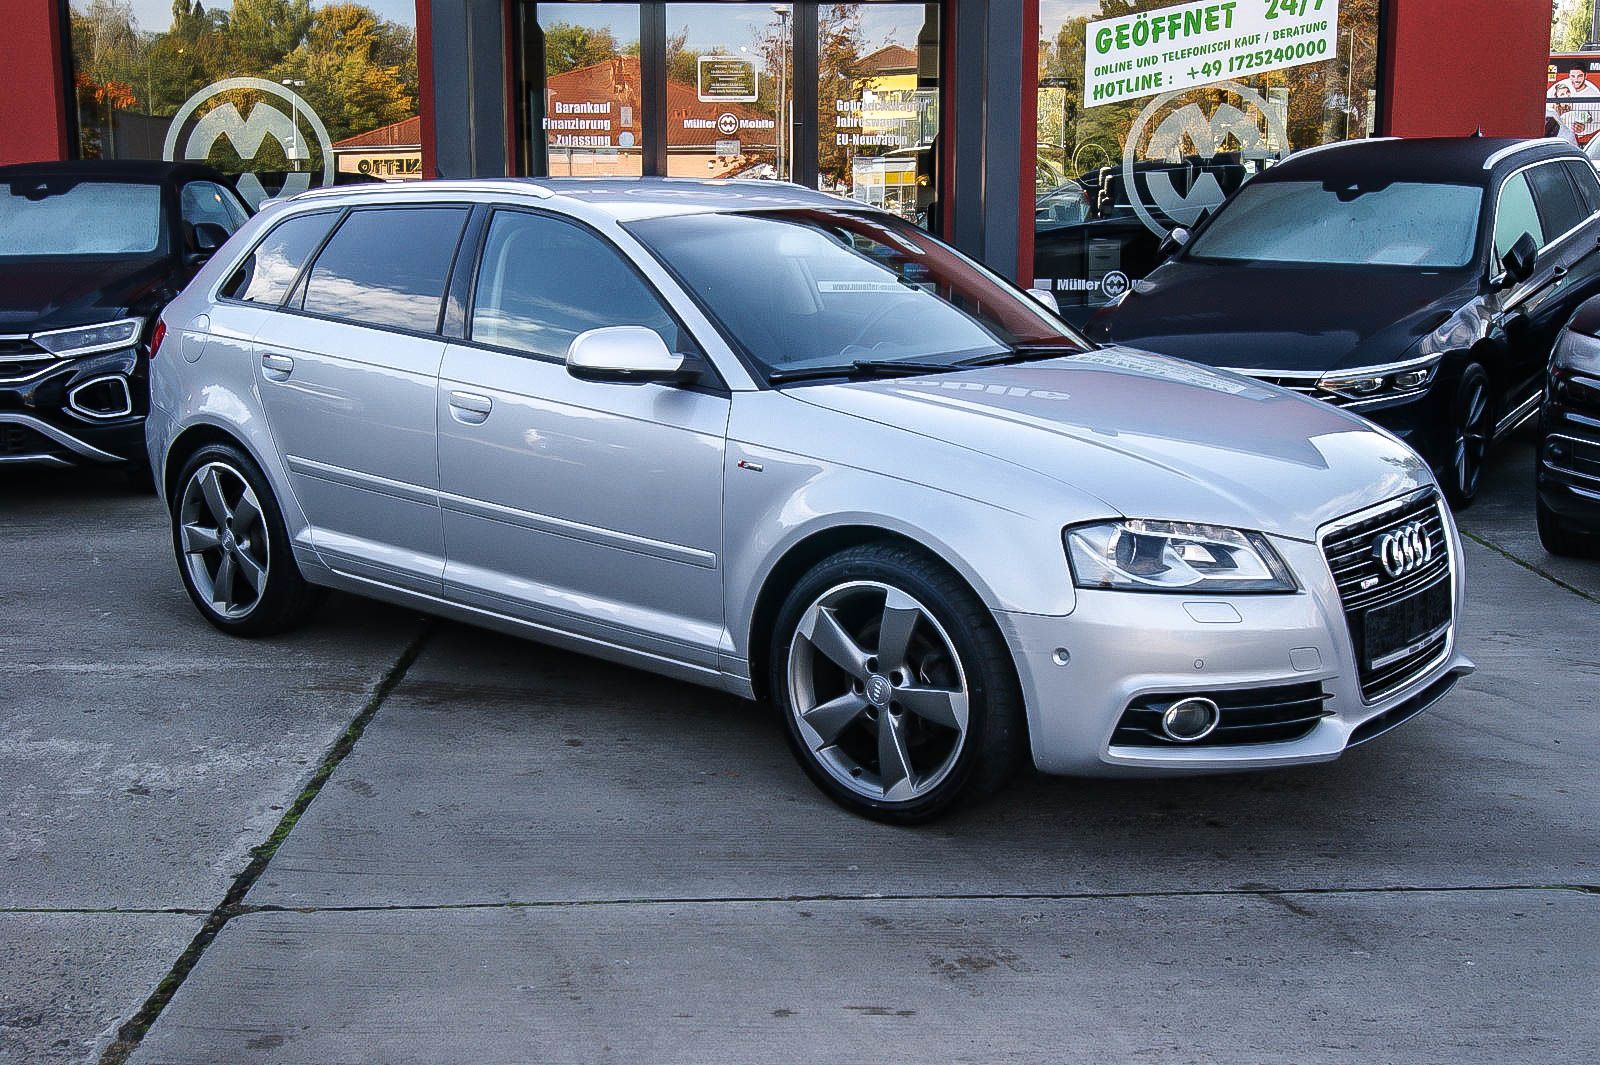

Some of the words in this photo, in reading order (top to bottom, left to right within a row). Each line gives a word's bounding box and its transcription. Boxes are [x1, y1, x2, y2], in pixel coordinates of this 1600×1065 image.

[1095, 2, 1237, 54] GEÖFFNET
[1094, 60, 1133, 77] ONLINE
[1136, 55, 1159, 68] UND
[1162, 39, 1231, 63] TELEFONISCH
[1234, 33, 1261, 48] KAUF
[1272, 20, 1328, 41] BERATUNG
[1093, 72, 1163, 100] HOTLINE
[1187, 59, 1222, 79] +49
[1228, 38, 1327, 73] 1725240000
[542, 118, 611, 131] Finanzierung
[683, 119, 717, 129] Müller
[739, 119, 775, 129] Mobile
[556, 134, 611, 147] Zulassung
[836, 133, 907, 147] EU-Neuwagen
[1057, 278, 1100, 291] Müller
